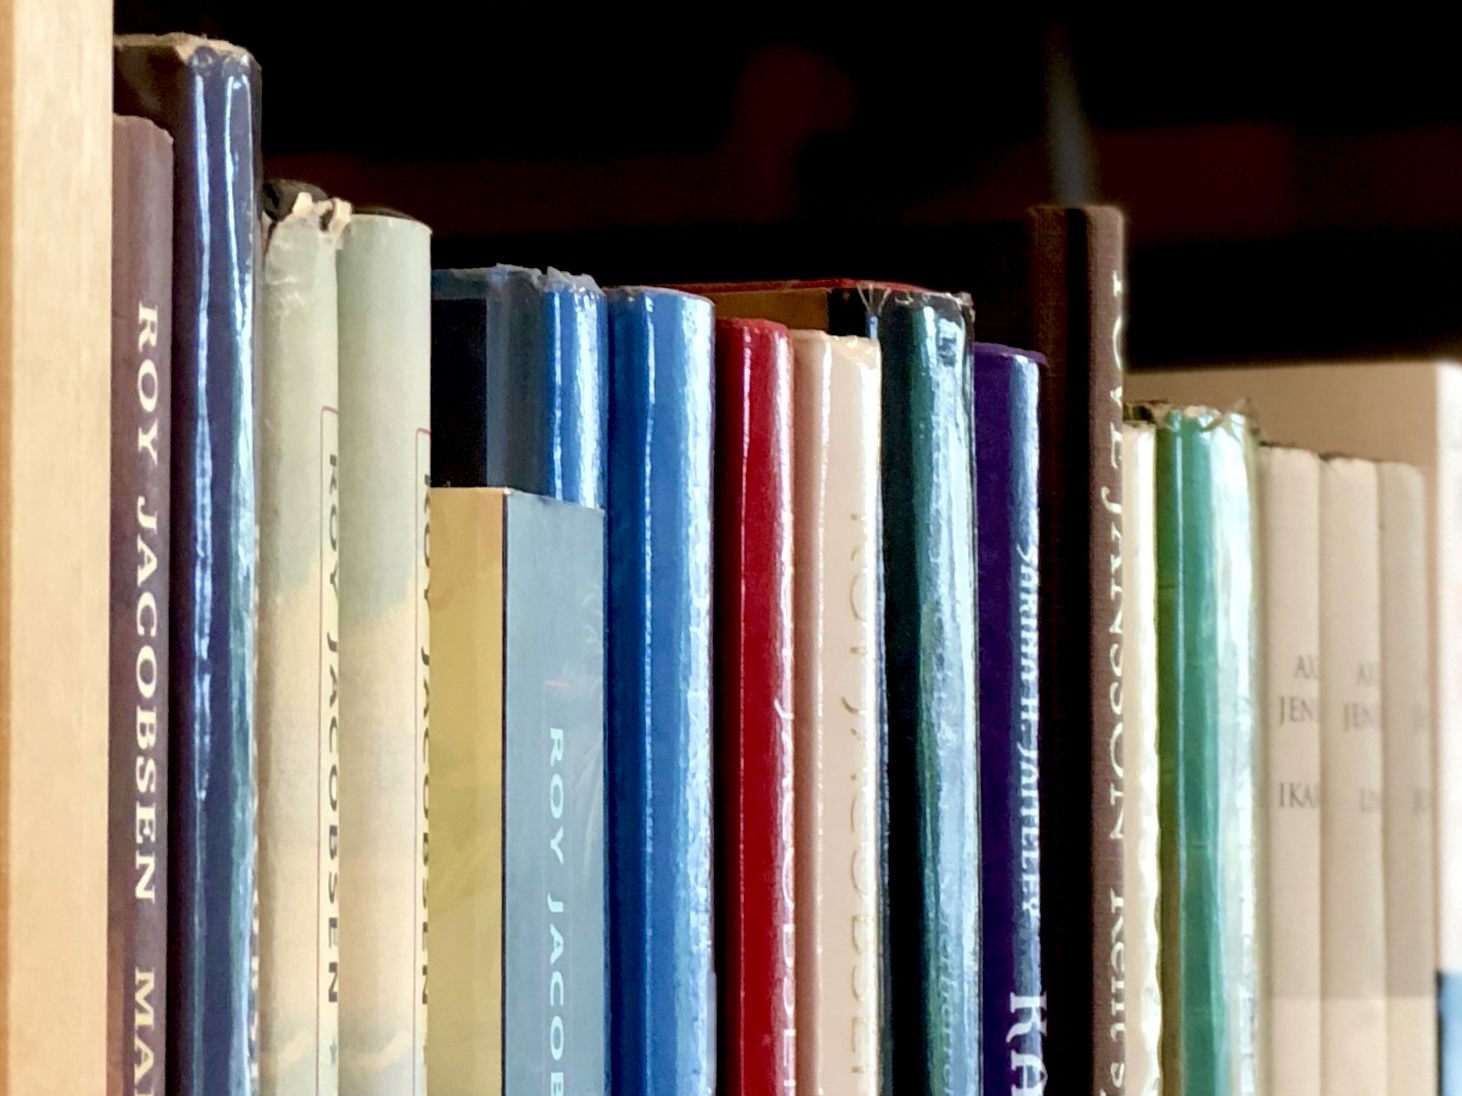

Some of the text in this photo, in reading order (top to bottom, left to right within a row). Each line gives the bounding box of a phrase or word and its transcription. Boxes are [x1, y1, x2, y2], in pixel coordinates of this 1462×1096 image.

[136, 301, 159, 467] ROY
[1015, 543, 1040, 682] SARINA
[133, 495, 160, 904] JACOBSEN
[1020, 695, 1039, 732] H.
[1278, 695, 1320, 727] JEN
[1343, 702, 1382, 733] JEN
[548, 726, 565, 865] ROY
[1278, 781, 1320, 809] IKA
